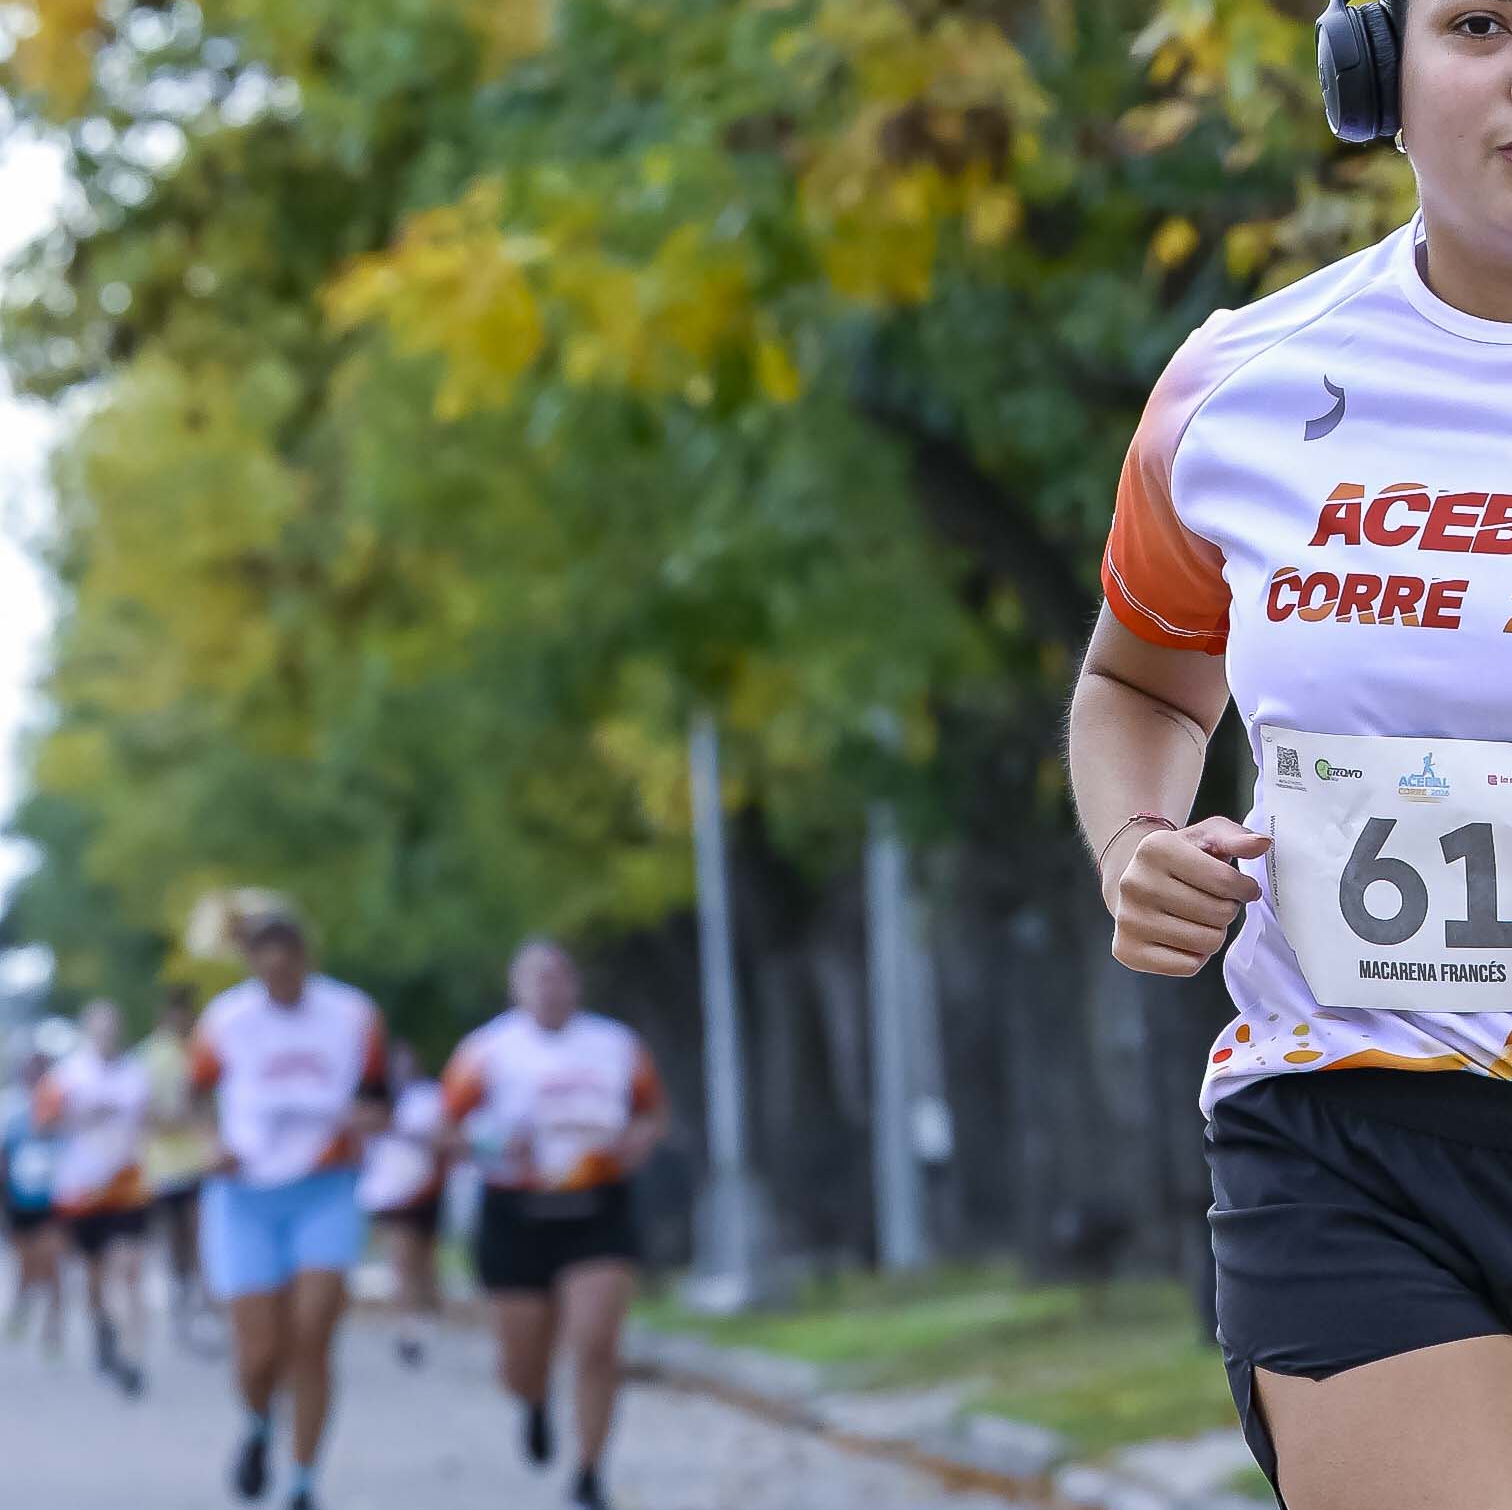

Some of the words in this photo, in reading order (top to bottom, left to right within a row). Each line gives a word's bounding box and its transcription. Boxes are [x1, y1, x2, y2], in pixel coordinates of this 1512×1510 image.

[1266, 567, 1470, 630] CORRE
[1359, 960, 1437, 982] MACARENA
[1440, 960, 1507, 983] FRANCÉS
